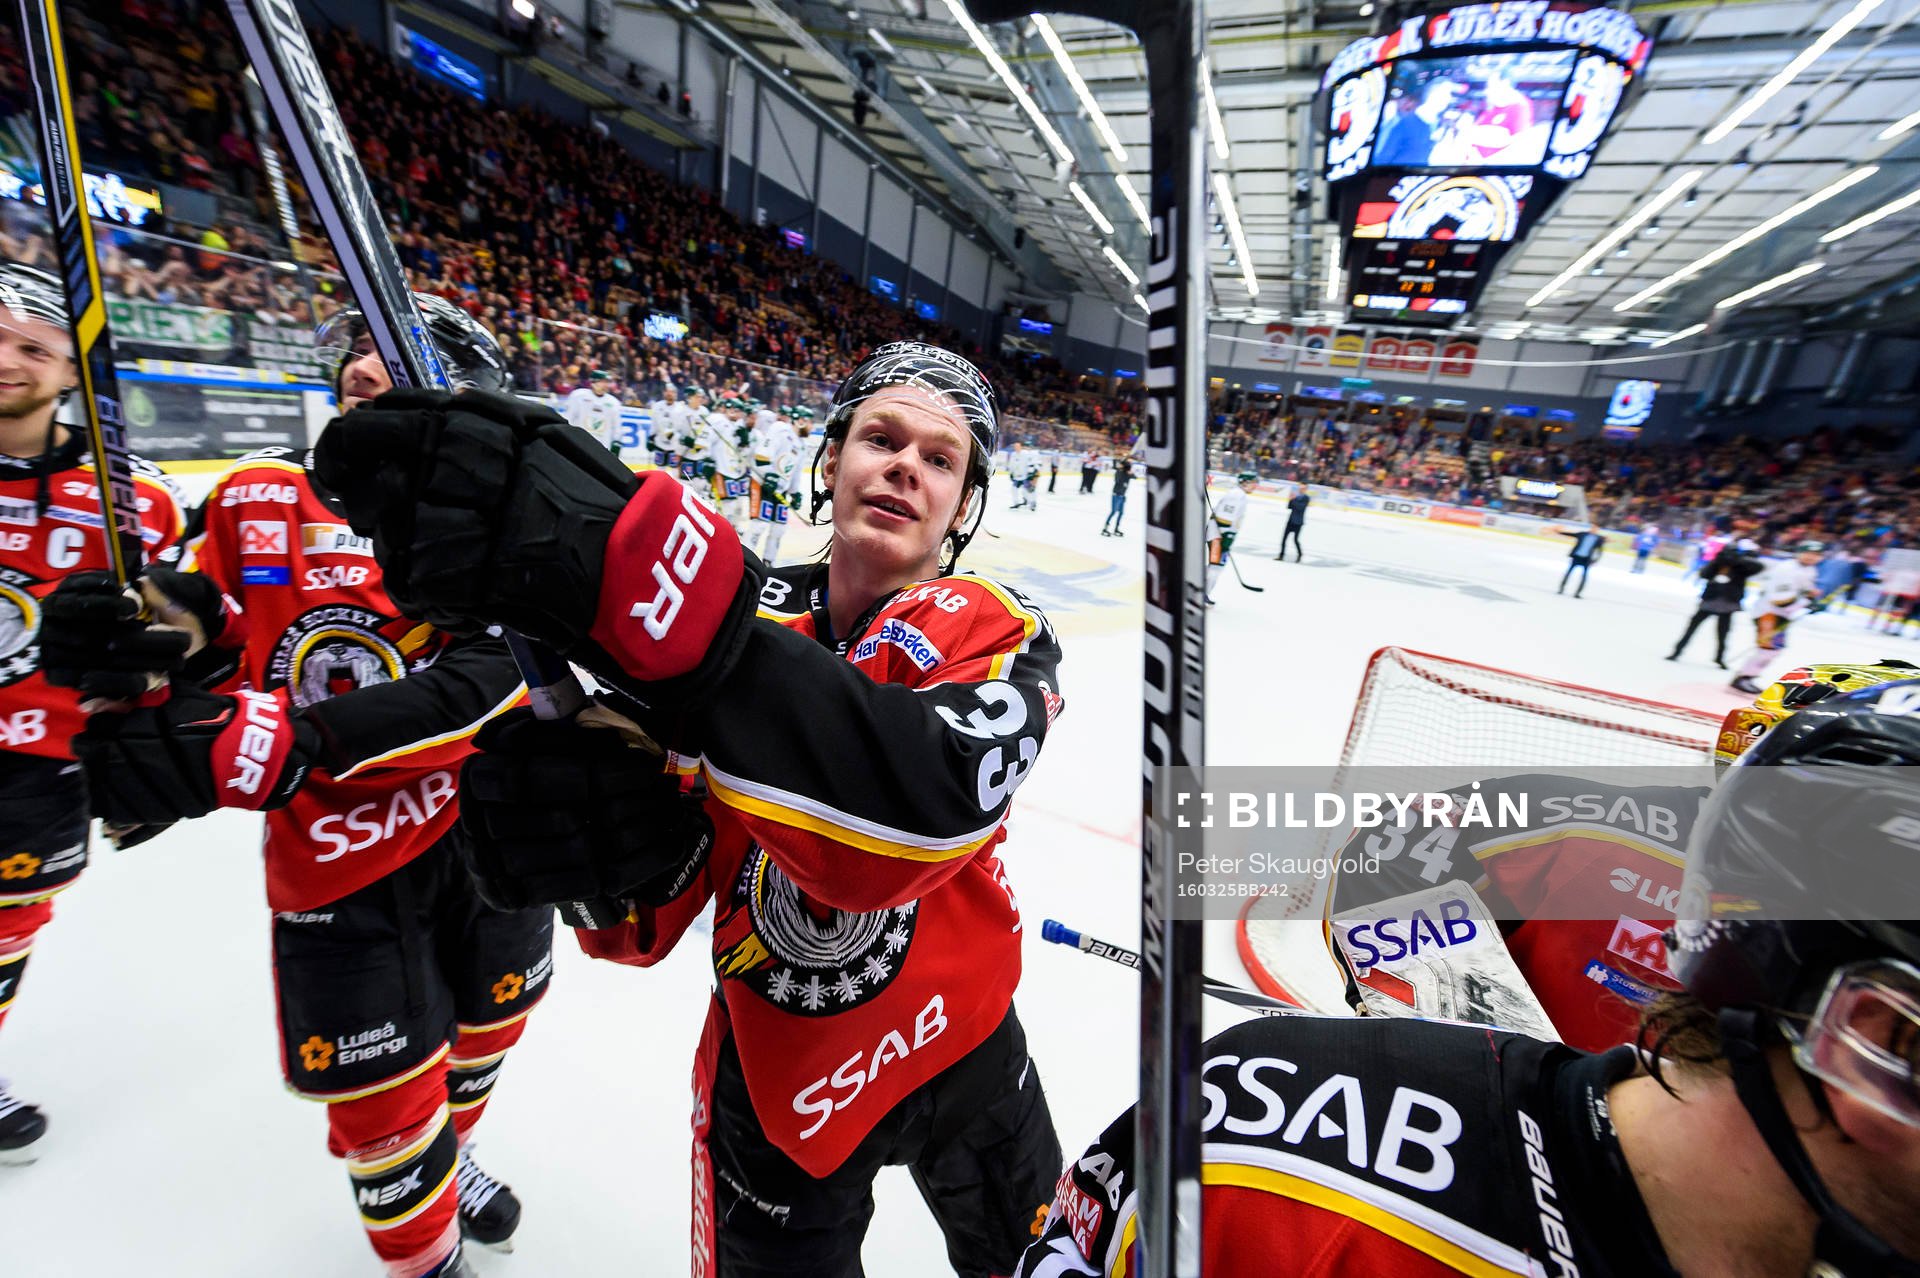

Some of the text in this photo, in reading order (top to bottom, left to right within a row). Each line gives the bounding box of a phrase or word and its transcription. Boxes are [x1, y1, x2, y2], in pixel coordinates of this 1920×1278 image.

[46, 526, 86, 569] C
[302, 565, 370, 591] SSAB
[934, 681, 1038, 813] 33
[308, 770, 457, 864] SSAB
[1540, 793, 1679, 842] SSAB
[1636, 878, 1681, 914] LK
[1346, 899, 1478, 969] SSAB
[1613, 927, 1670, 974] MA
[337, 1035, 408, 1066] Energi
[792, 993, 949, 1141] SSAB
[1200, 1054, 1463, 1193] SSAB
[358, 1163, 424, 1208] NEX
